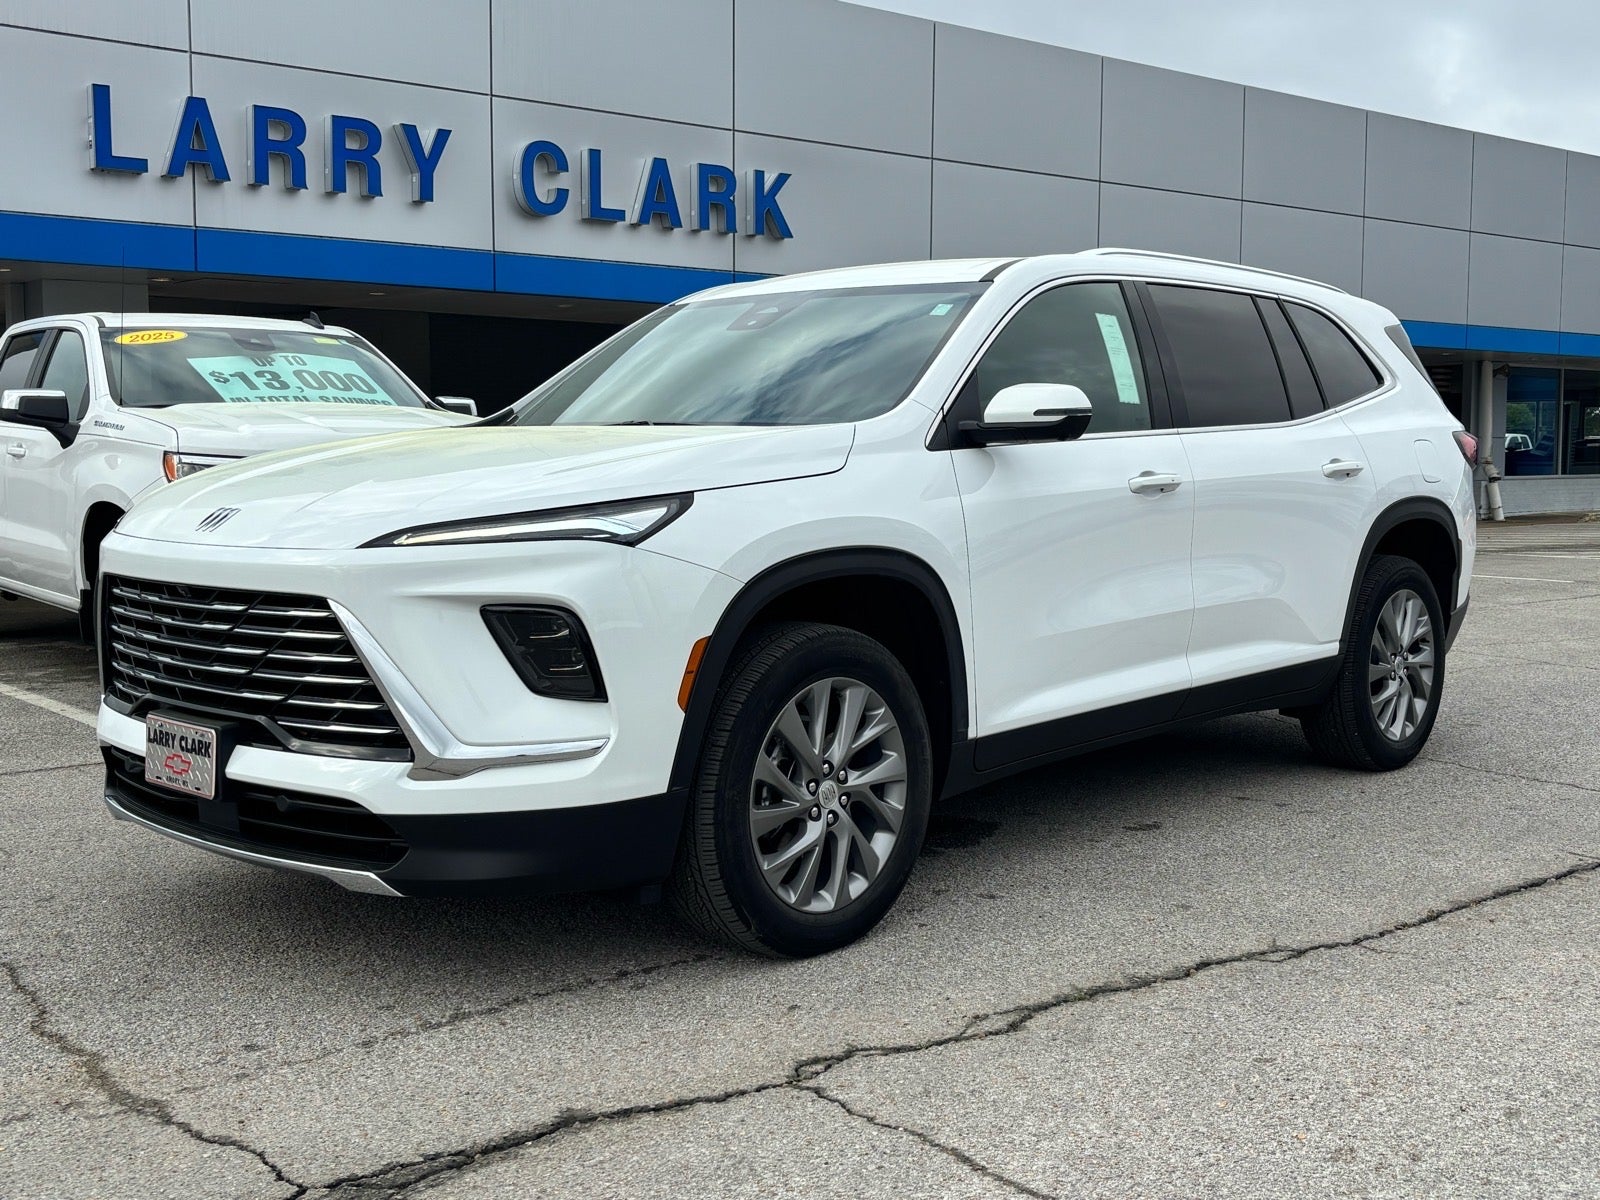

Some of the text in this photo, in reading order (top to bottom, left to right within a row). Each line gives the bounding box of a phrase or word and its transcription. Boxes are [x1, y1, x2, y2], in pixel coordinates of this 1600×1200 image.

[88, 83, 793, 239] LARRY CLARK
[129, 332, 175, 343] 2025
[251, 355, 308, 367] UP TO
[209, 369, 378, 394] $13,000
[147, 727, 211, 758] LARRY CLARK
